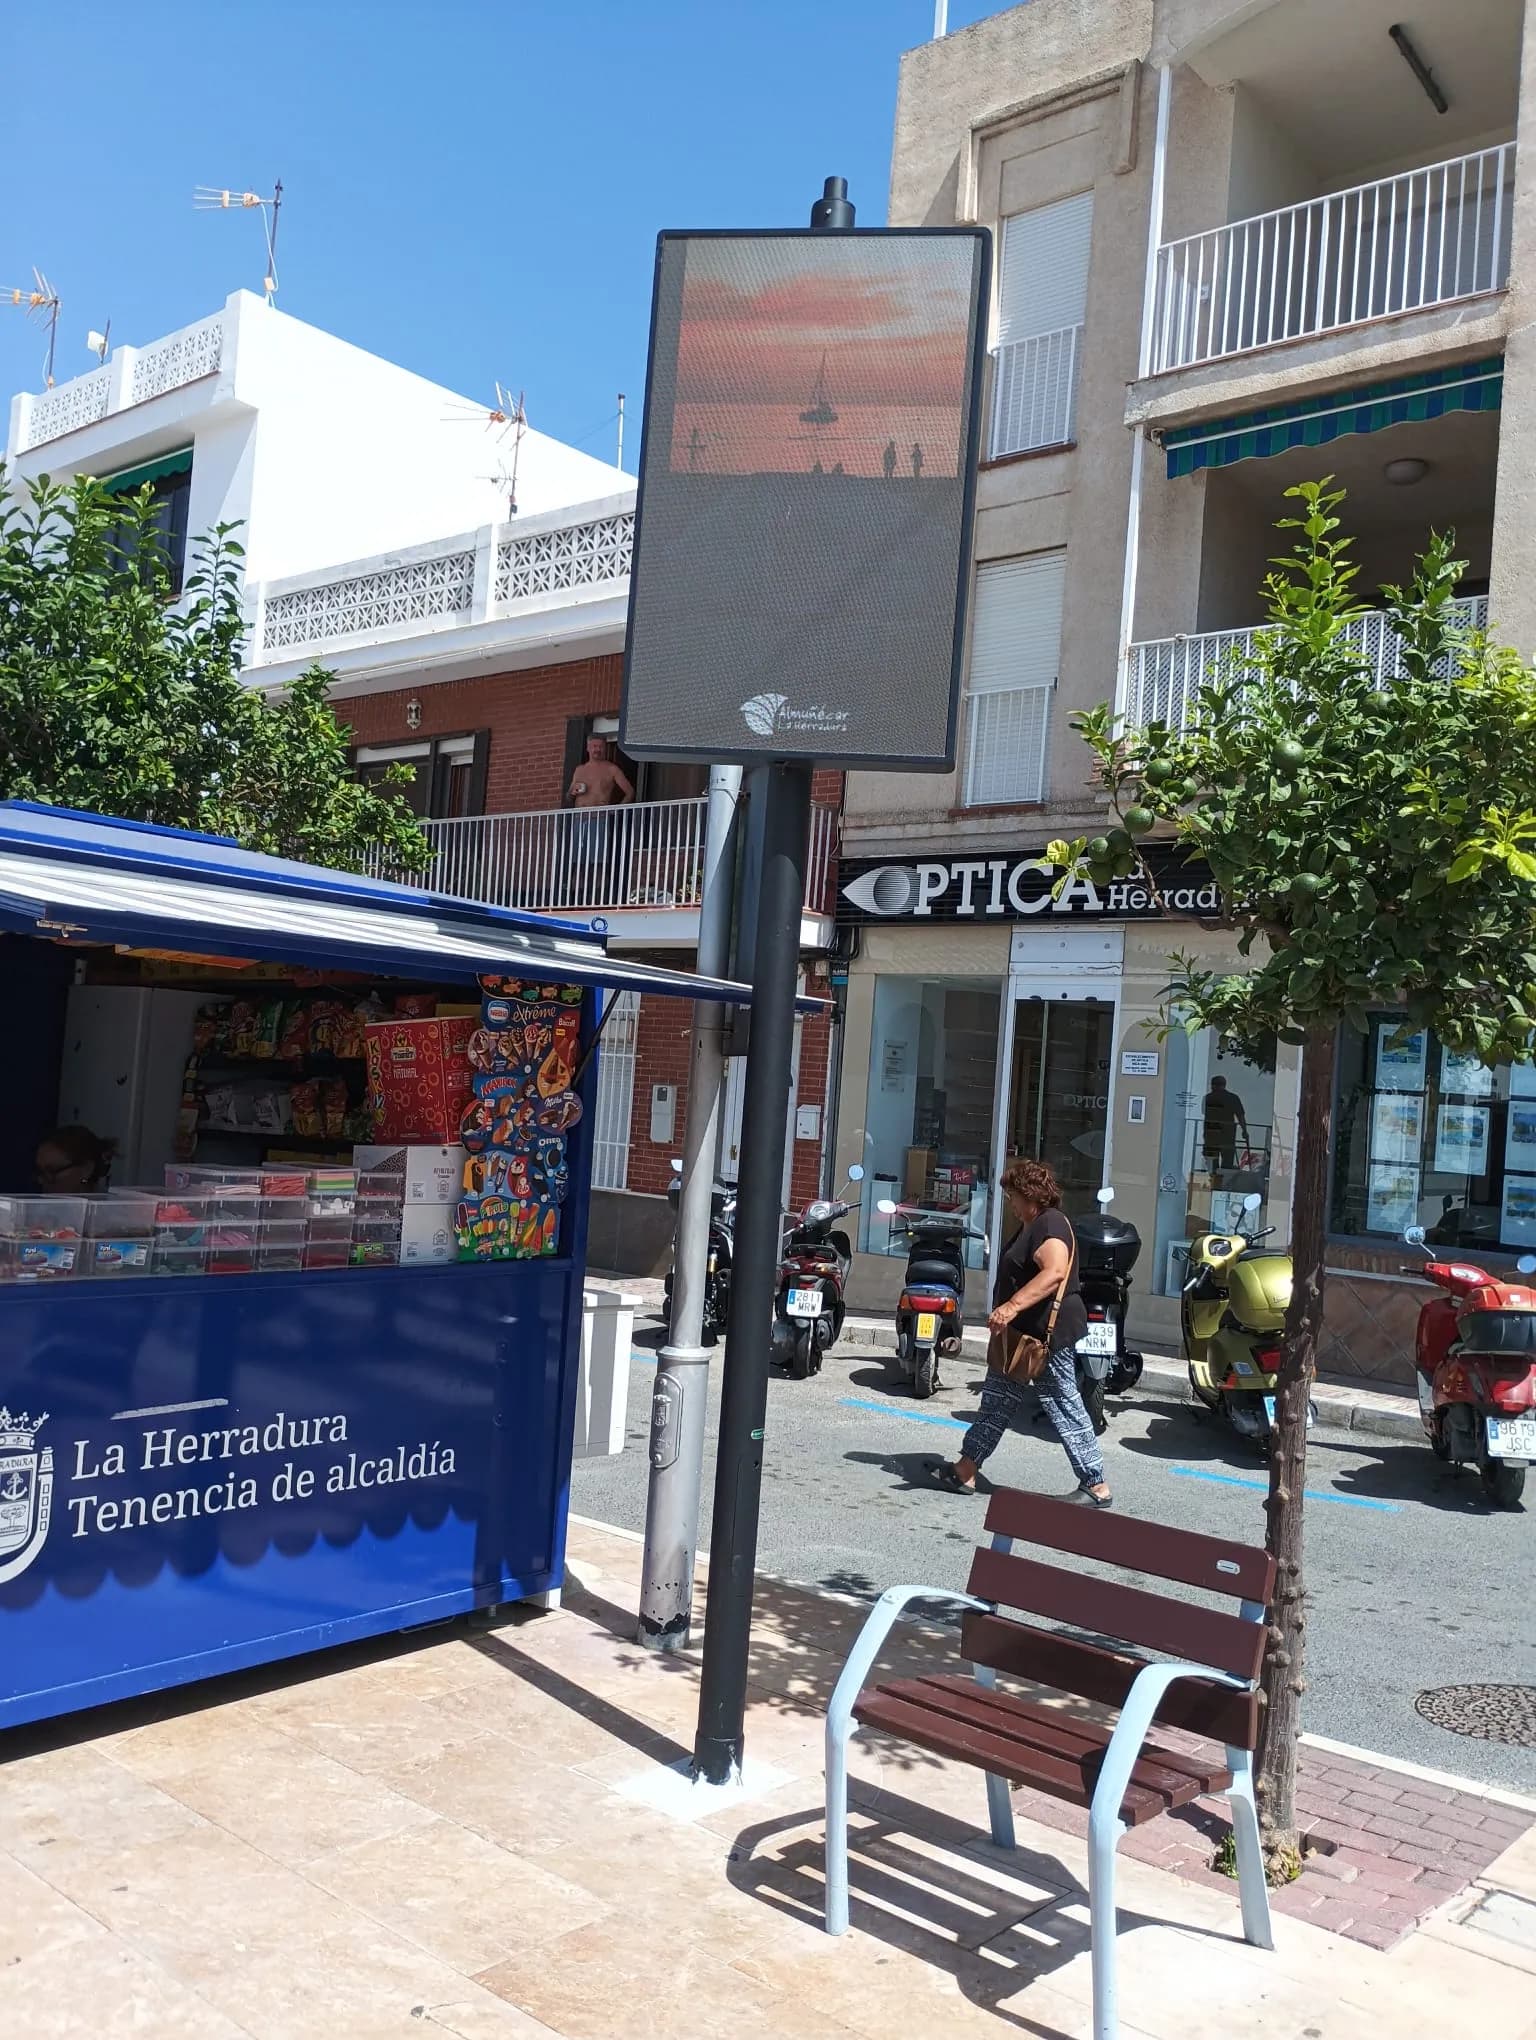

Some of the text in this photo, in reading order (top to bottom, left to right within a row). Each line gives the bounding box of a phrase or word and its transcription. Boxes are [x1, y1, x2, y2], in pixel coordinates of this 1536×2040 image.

[778, 704, 849, 720] Almuñécar
[1087, 1326, 1114, 1337] 439
[1085, 1337, 1107, 1348] NRM
[71, 1413, 348, 1480] La Herradura
[1506, 1438, 1531, 1451] JSC
[68, 1441, 456, 1537] Tenencia de alcaldía
